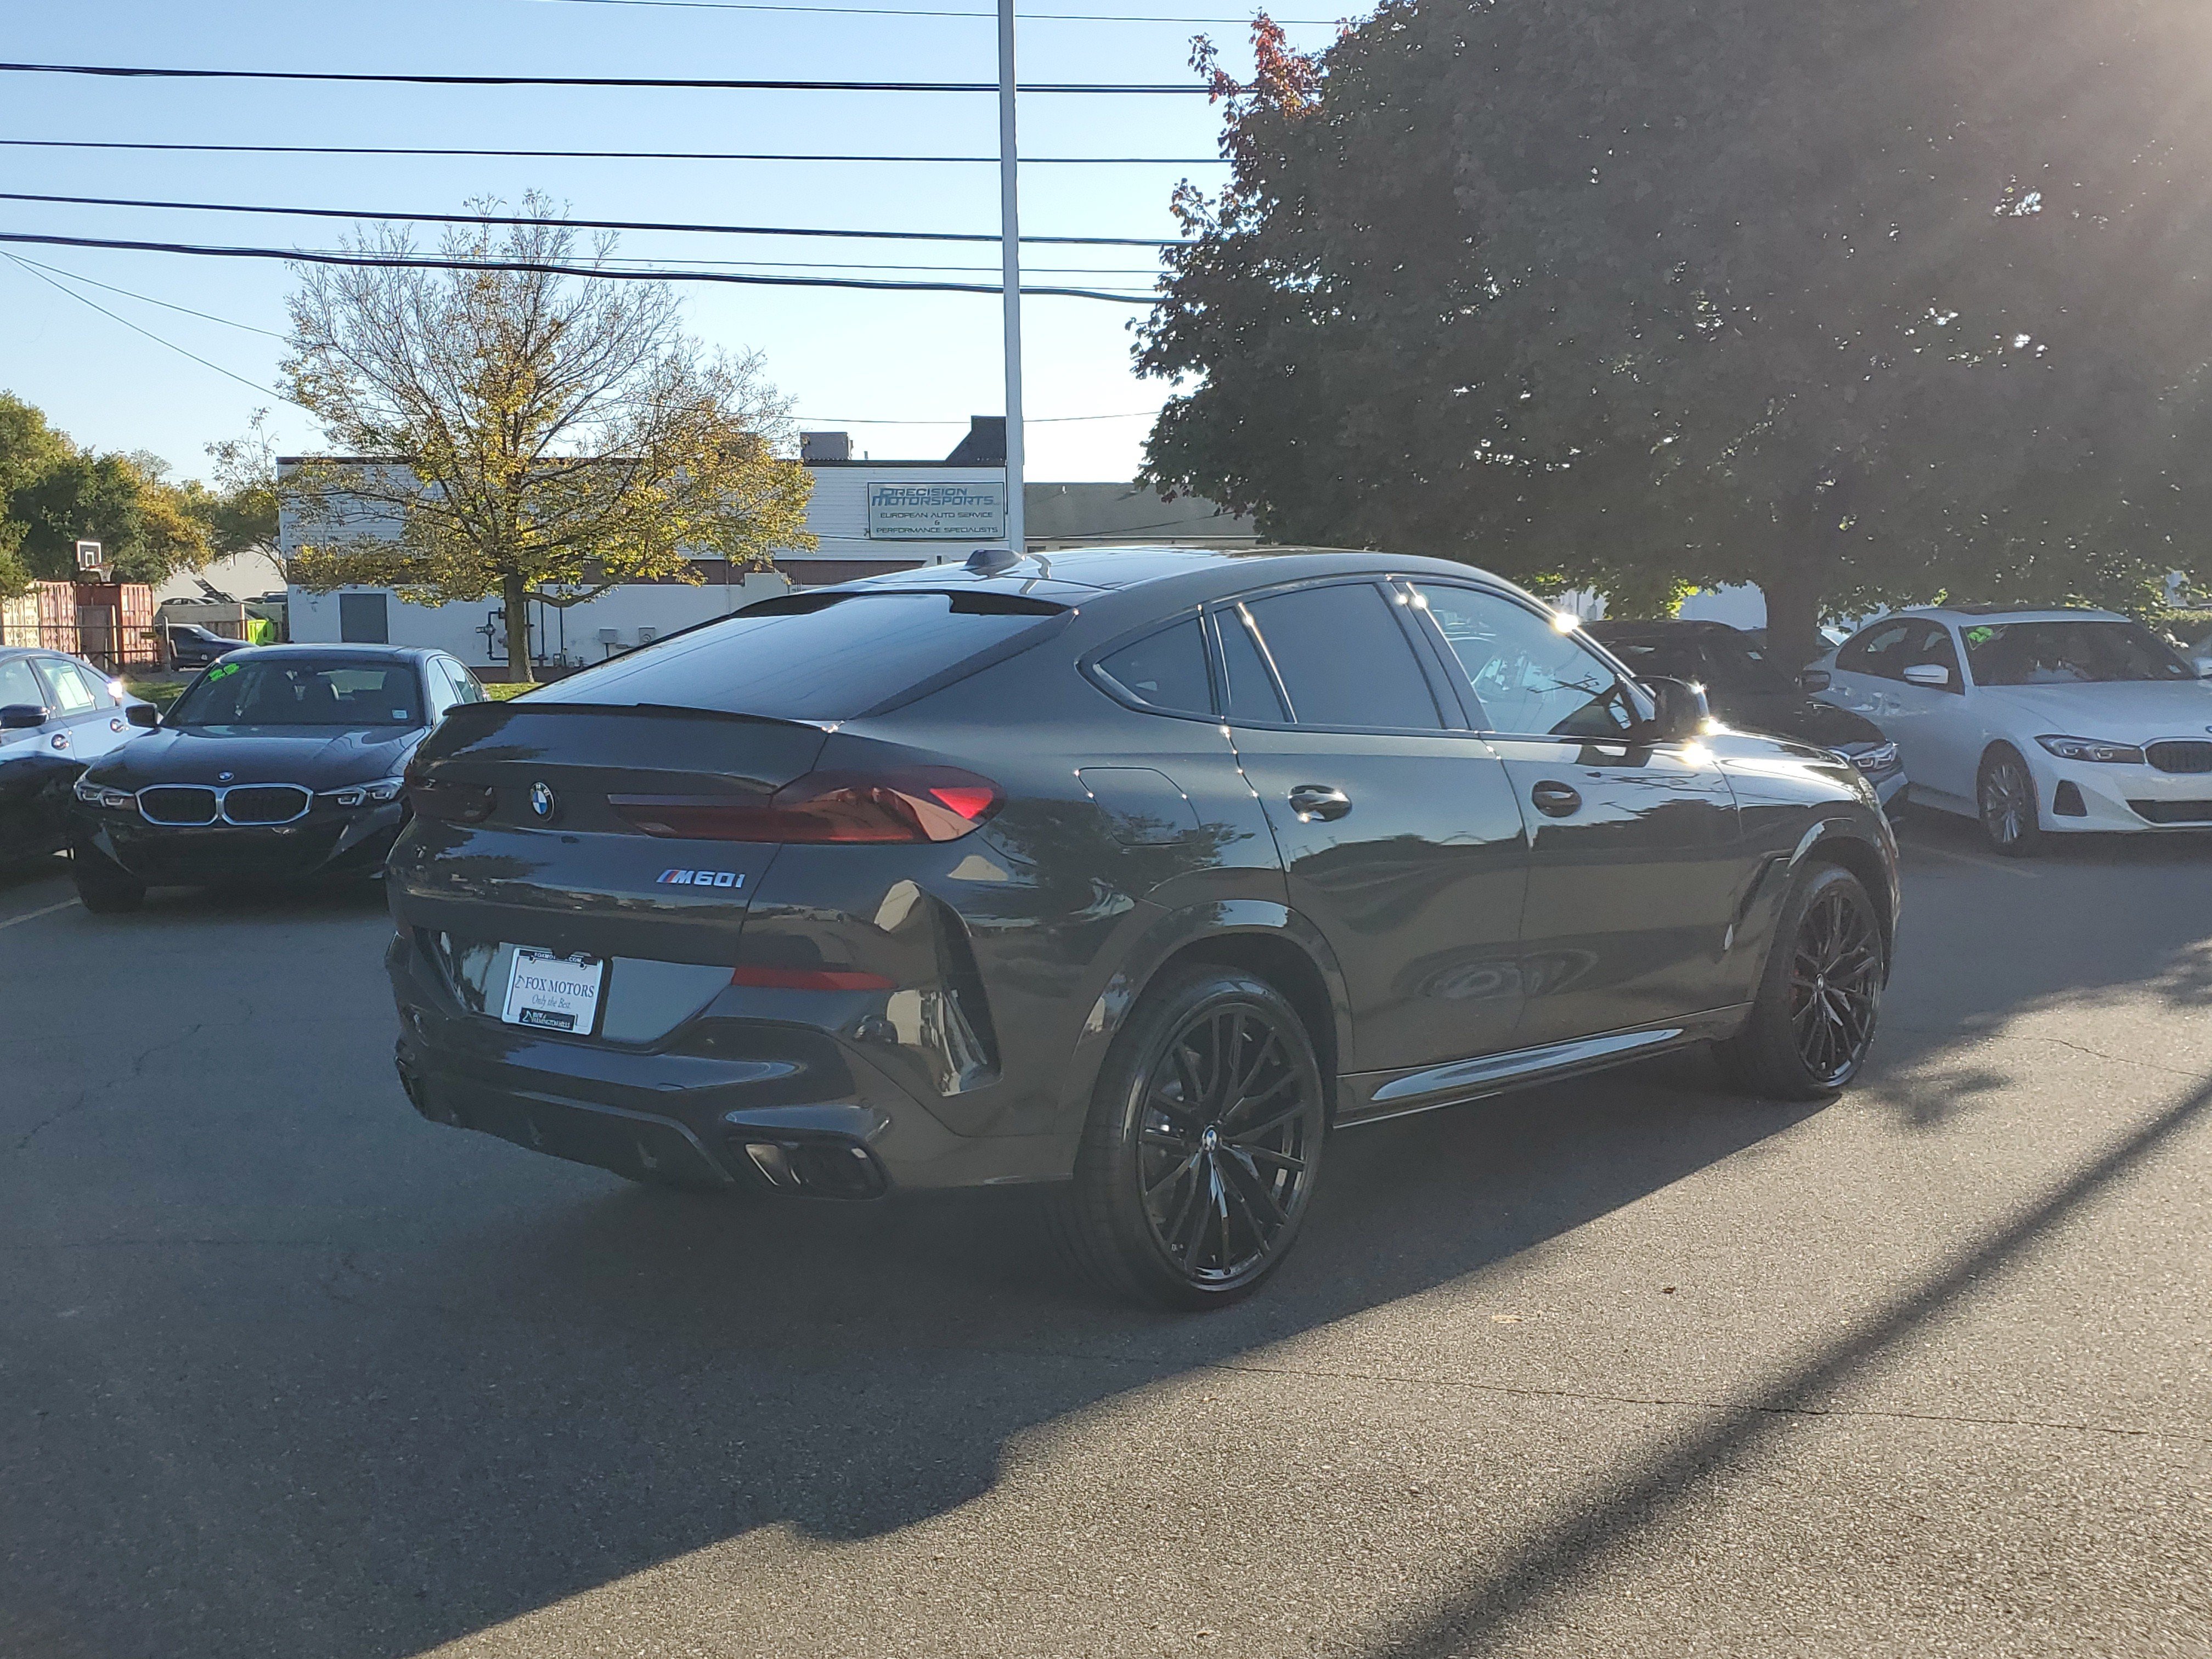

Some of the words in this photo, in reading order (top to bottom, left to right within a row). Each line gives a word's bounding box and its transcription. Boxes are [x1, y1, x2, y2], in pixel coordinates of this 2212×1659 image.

[879, 488, 968, 496] PRECISION
[871, 495, 994, 506] MOTORSPORTS
[525, 977, 547, 991] FOX
[548, 979, 595, 998] MOTORS
[532, 994, 546, 1009] Only
[547, 996, 557, 1007] the
